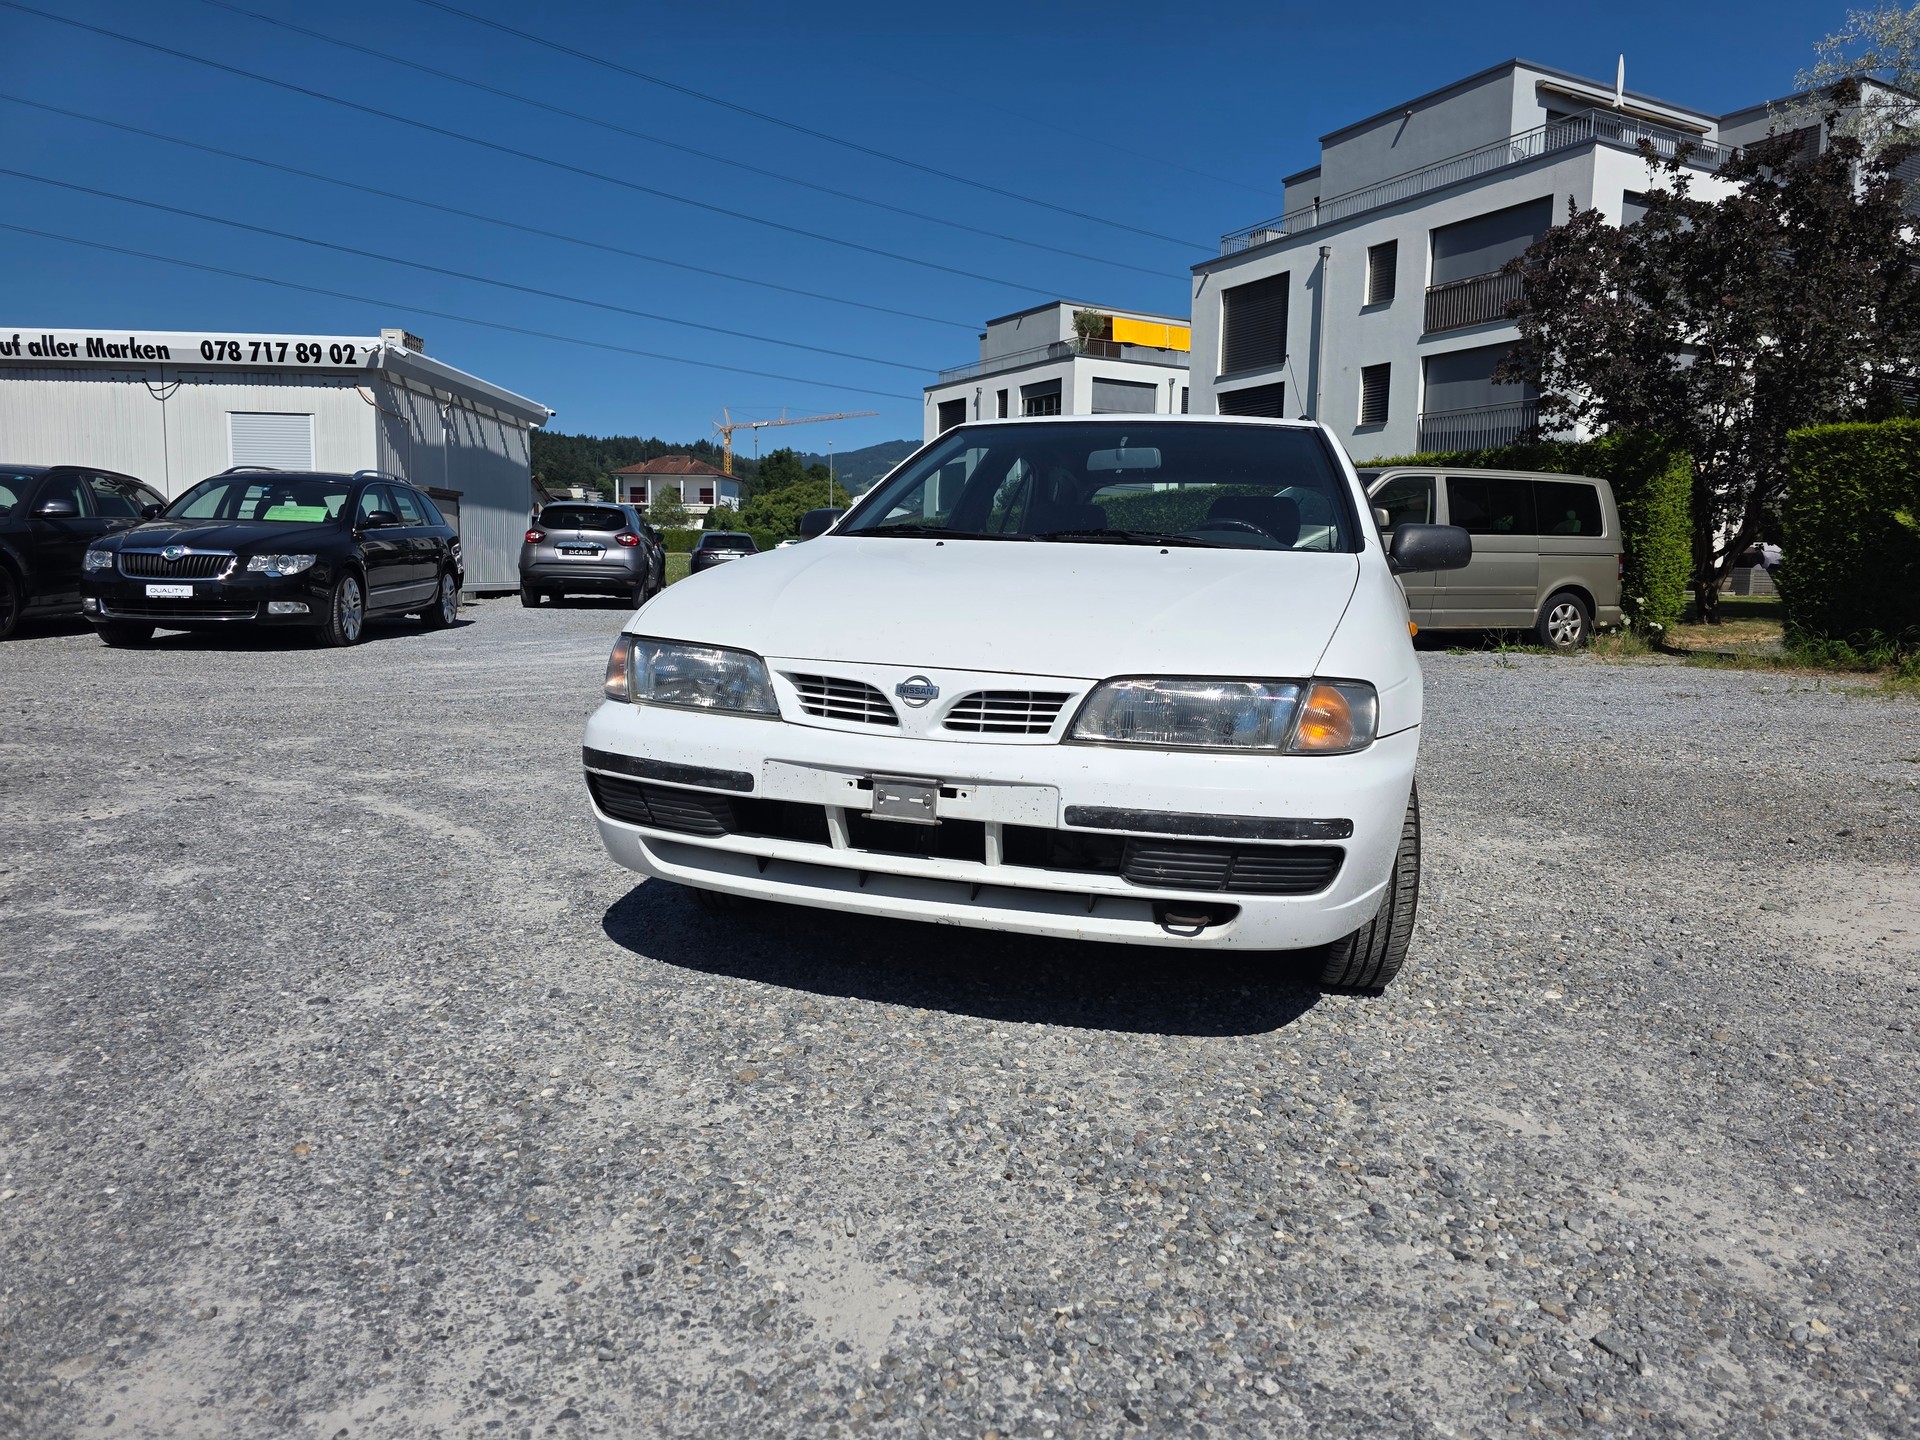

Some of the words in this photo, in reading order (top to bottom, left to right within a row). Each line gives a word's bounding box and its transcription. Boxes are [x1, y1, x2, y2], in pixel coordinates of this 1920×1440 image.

[0, 333, 21, 356] uf
[27, 334, 79, 358] aller
[86, 336, 171, 360] Marken
[200, 340, 242, 362] 078
[248, 341, 289, 363] 717
[295, 342, 322, 364] 89
[329, 343, 357, 365] 02
[899, 686, 934, 696] NISSAN
